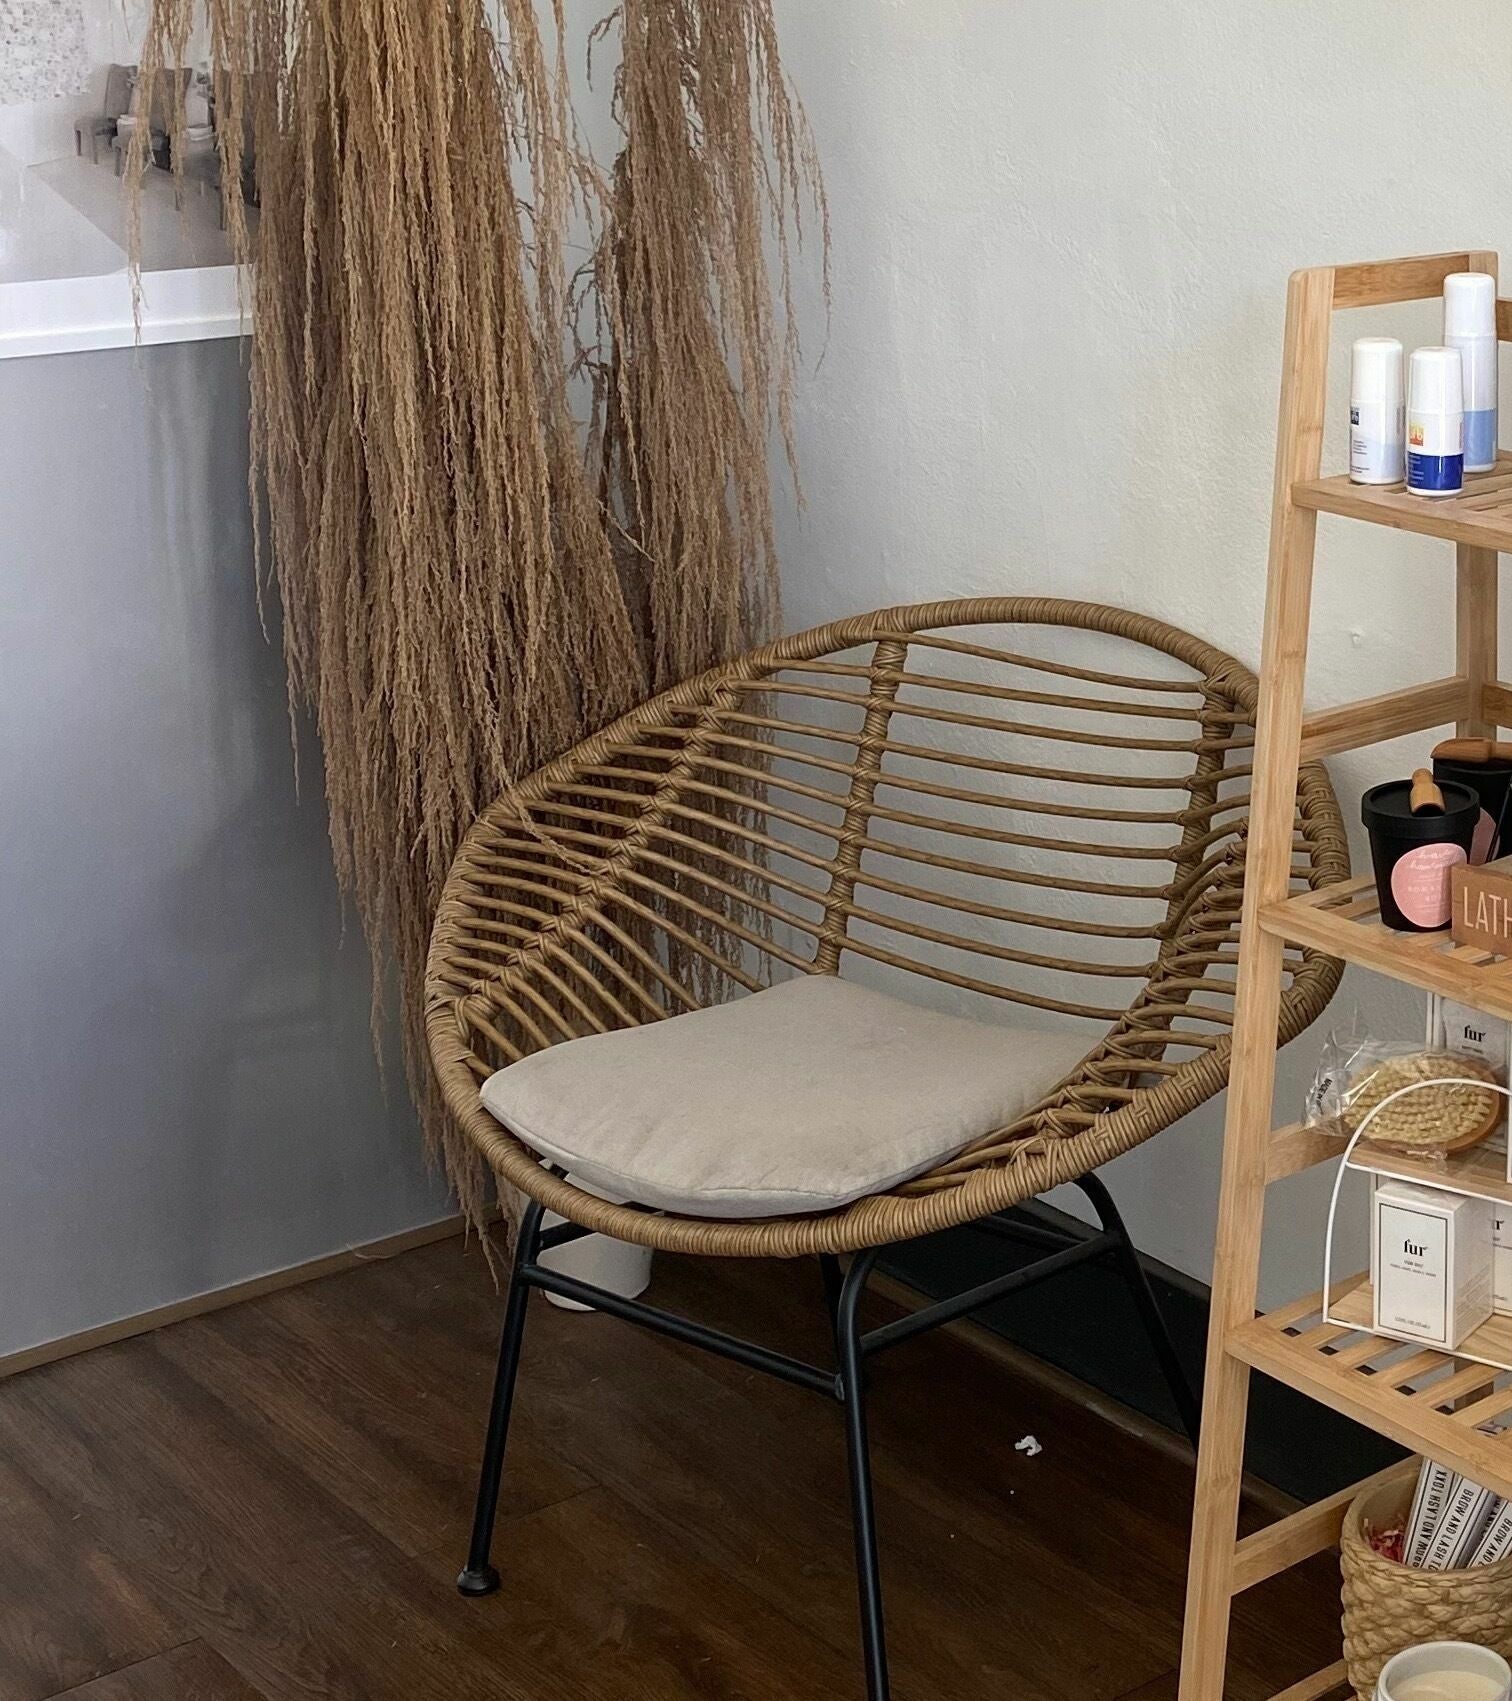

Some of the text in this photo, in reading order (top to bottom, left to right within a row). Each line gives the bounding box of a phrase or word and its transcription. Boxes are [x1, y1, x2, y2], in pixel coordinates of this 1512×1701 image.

[1464, 1025, 1486, 1042] fur
[1404, 1238, 1428, 1257] fur
[1431, 1470, 1448, 1494] TOXX
[1424, 1494, 1441, 1521] LASH
[1454, 1488, 1475, 1517] BROW
[1420, 1521, 1435, 1541] AND
[1445, 1515, 1461, 1535] AND
[1434, 1534, 1452, 1560] LASH
[1482, 1542, 1498, 1563] AND
